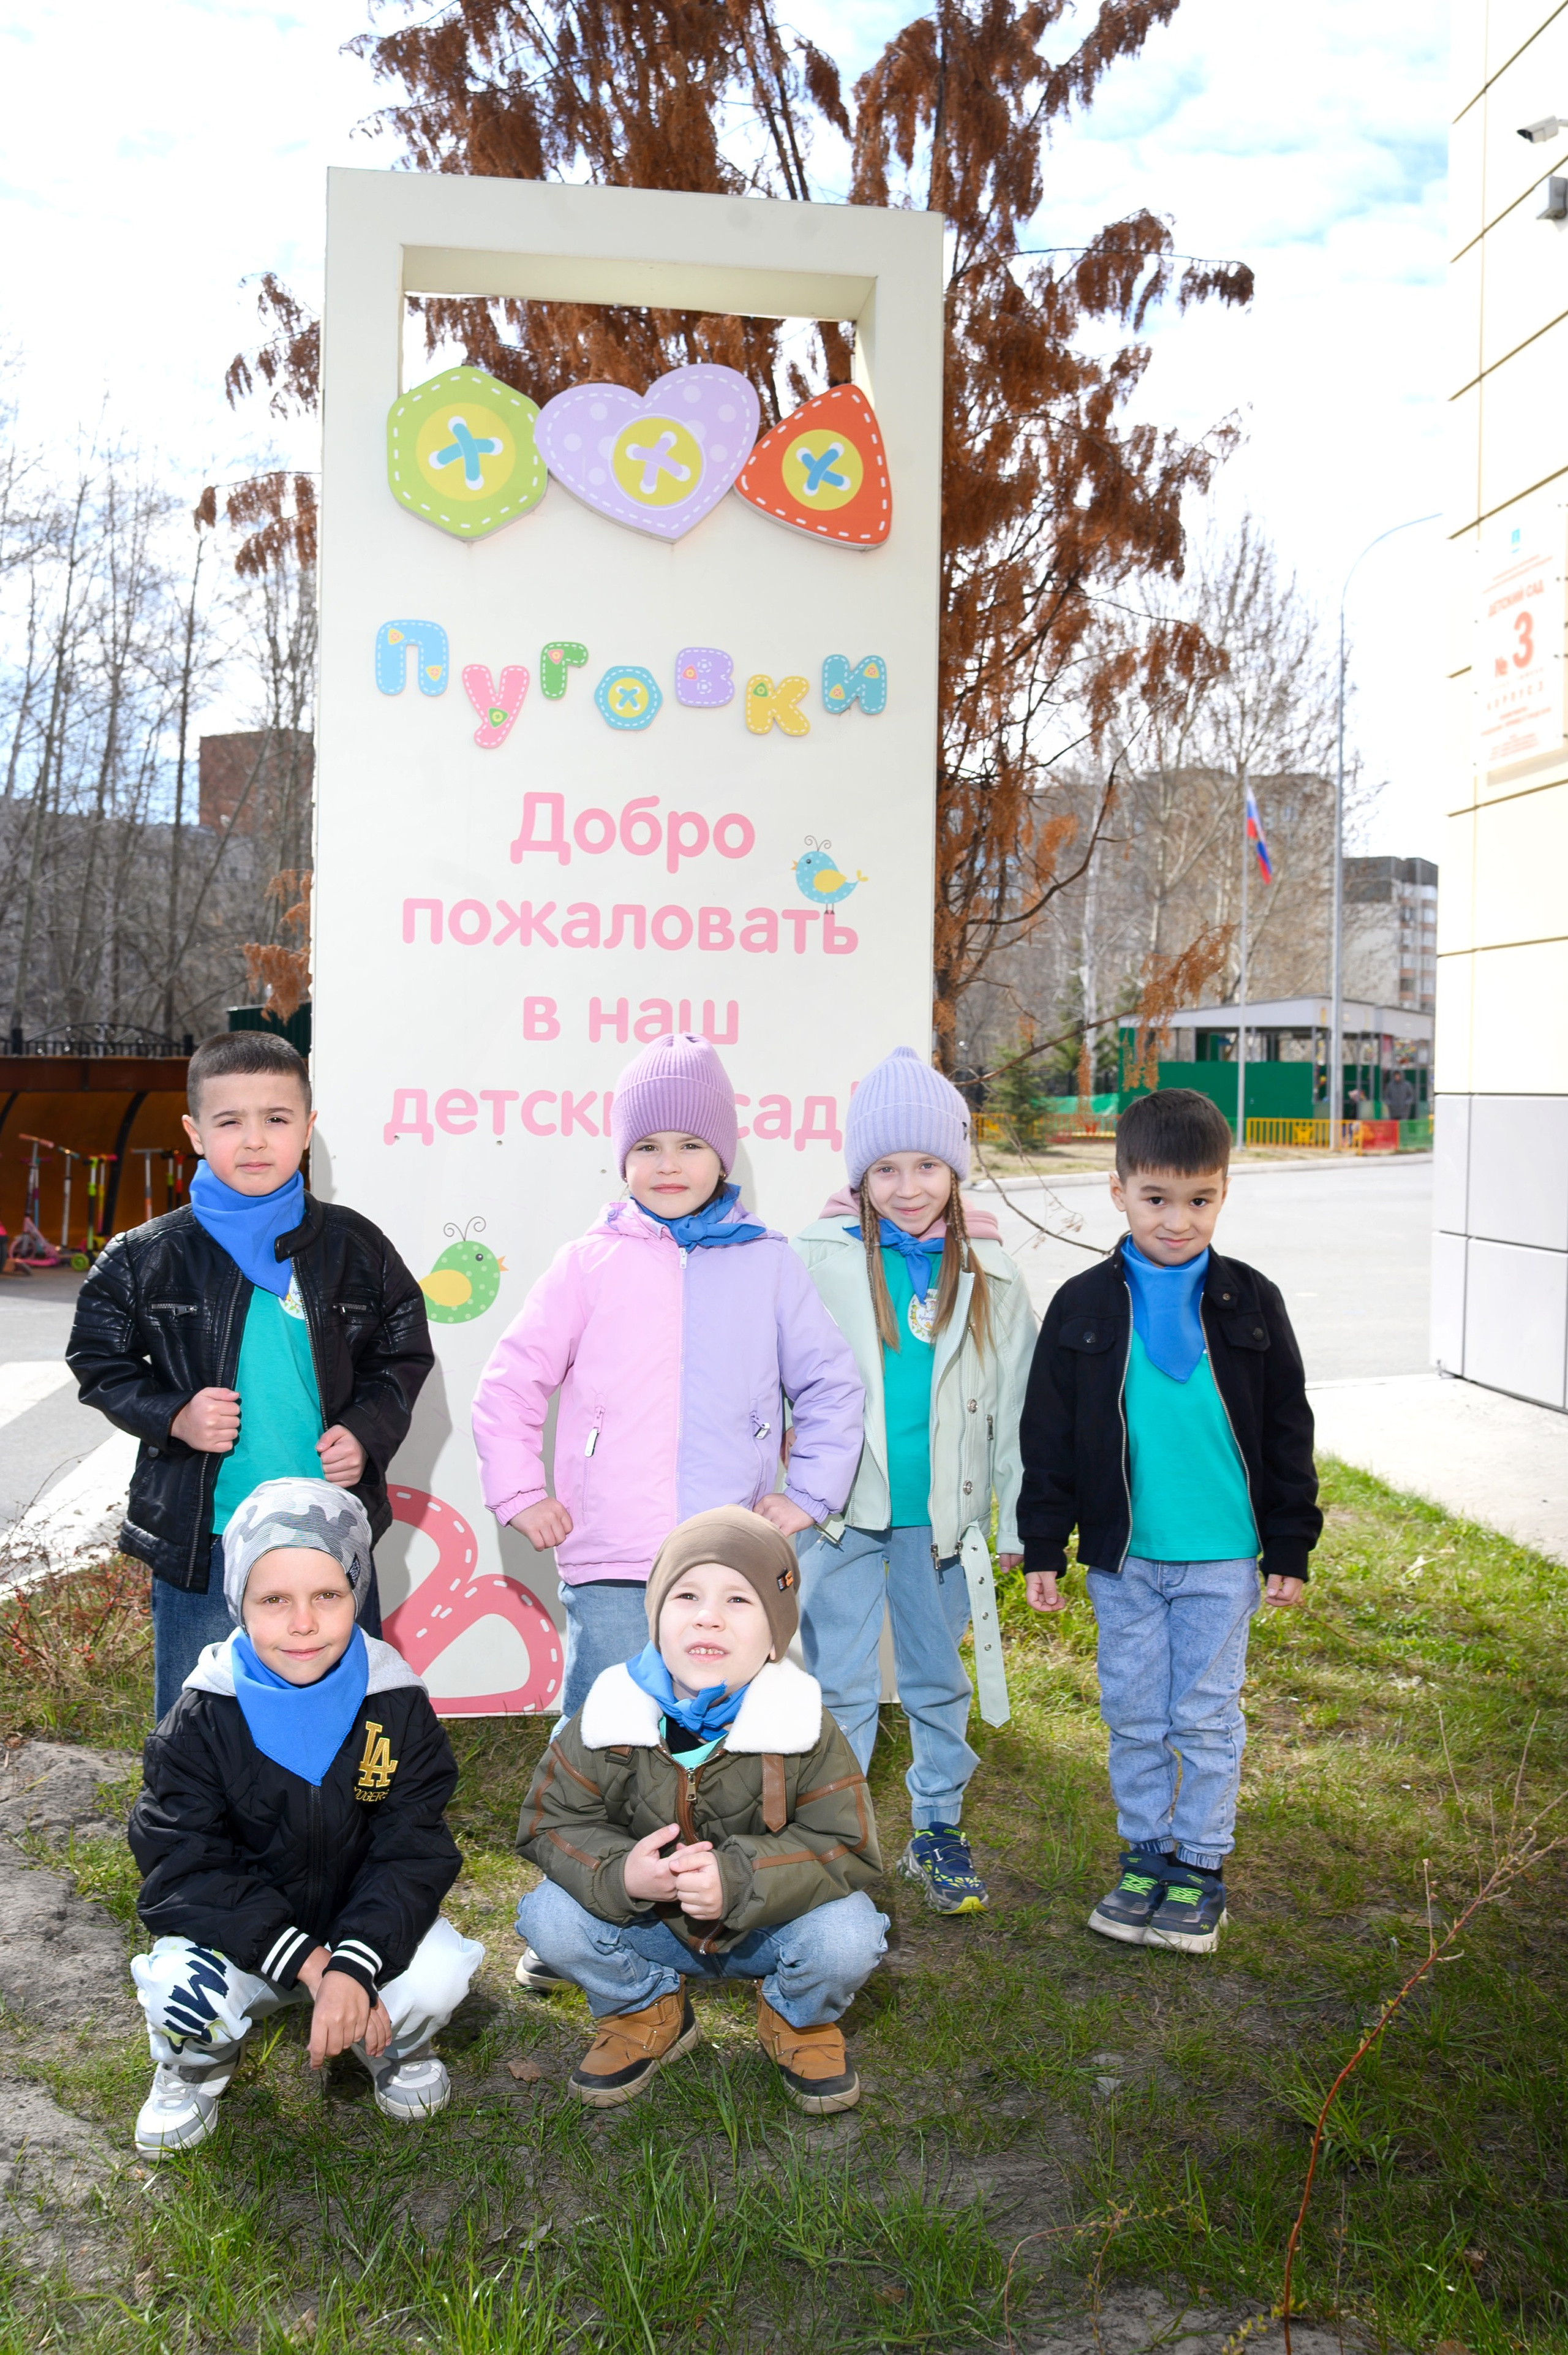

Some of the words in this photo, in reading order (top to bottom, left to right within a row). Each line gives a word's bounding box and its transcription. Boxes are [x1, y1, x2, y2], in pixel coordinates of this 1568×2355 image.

[1512, 611, 1534, 668] 3
[510, 792, 755, 874] Добро
[402, 898, 859, 954] пожаловать
[522, 996, 561, 1041] в
[589, 997, 739, 1045] наш
[383, 1087, 614, 1147] детск
[734, 1081, 861, 1152] ад
[358, 1721, 399, 1788] LA
